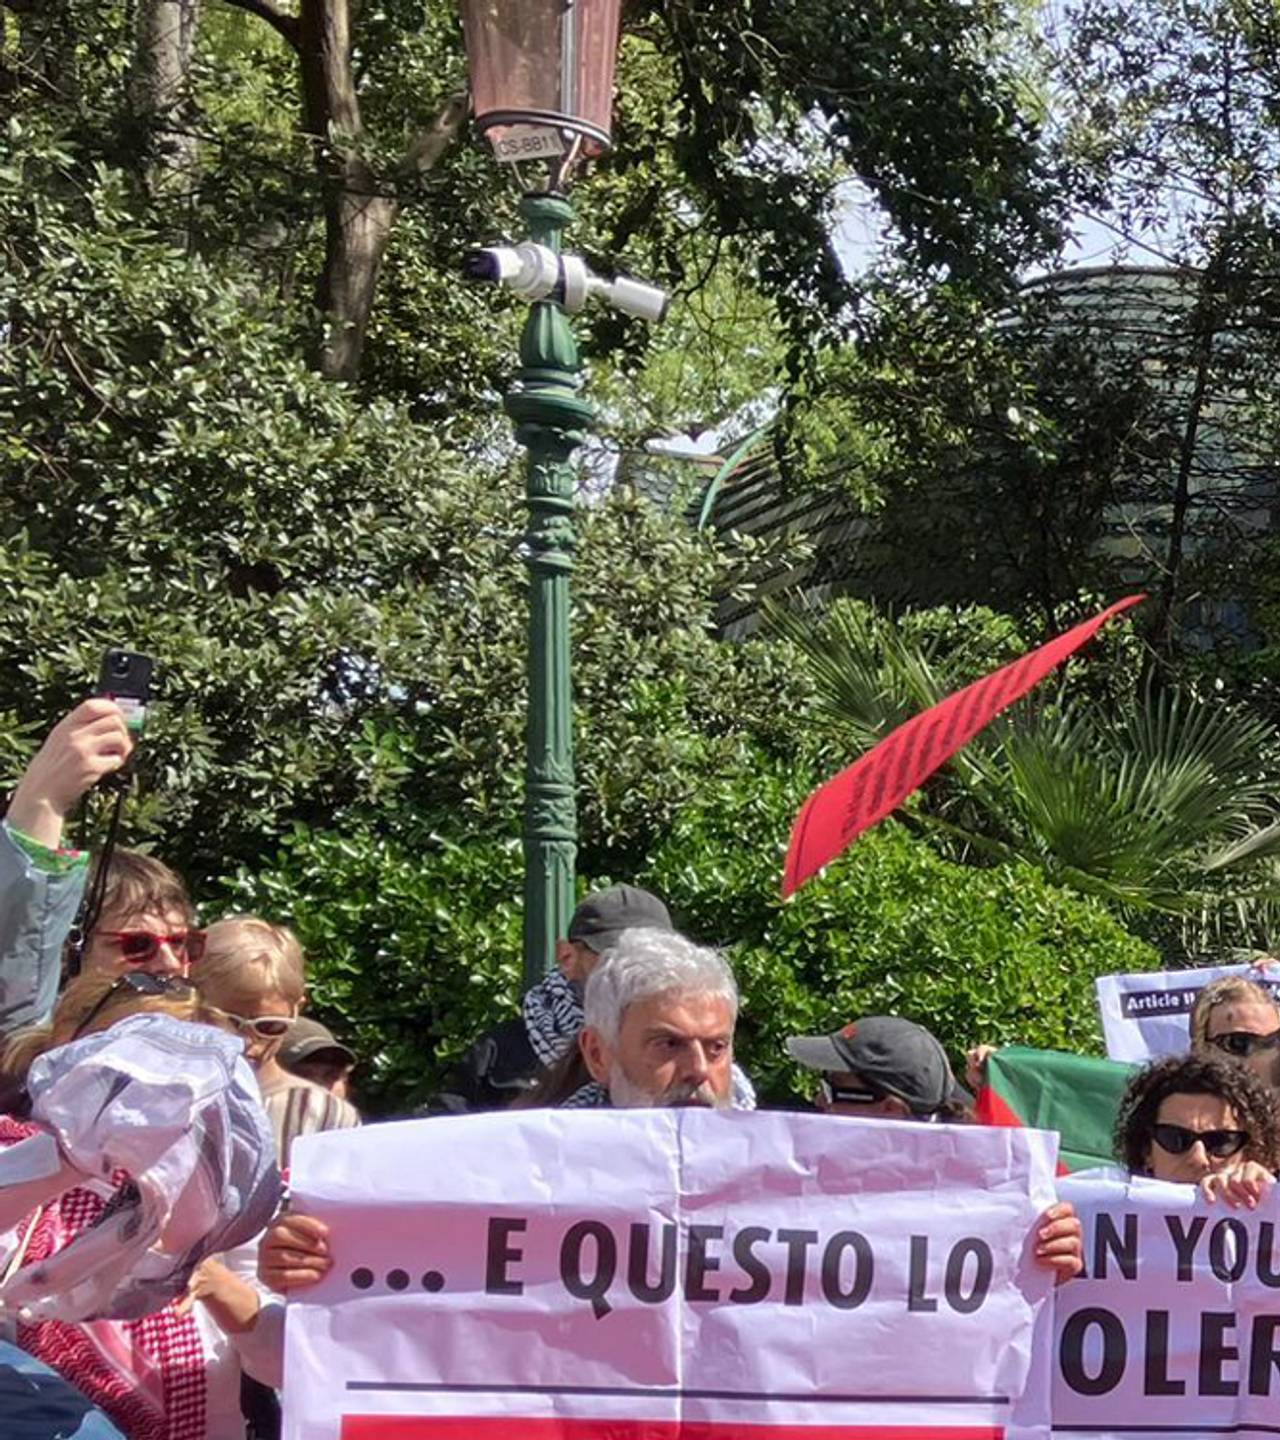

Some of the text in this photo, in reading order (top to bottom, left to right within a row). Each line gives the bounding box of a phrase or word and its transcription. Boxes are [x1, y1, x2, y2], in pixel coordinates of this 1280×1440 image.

[1126, 990, 1180, 1012] Article
[485, 1217, 526, 1295] E
[558, 1217, 898, 1321] QUESTO
[905, 1234, 995, 1315] LO
